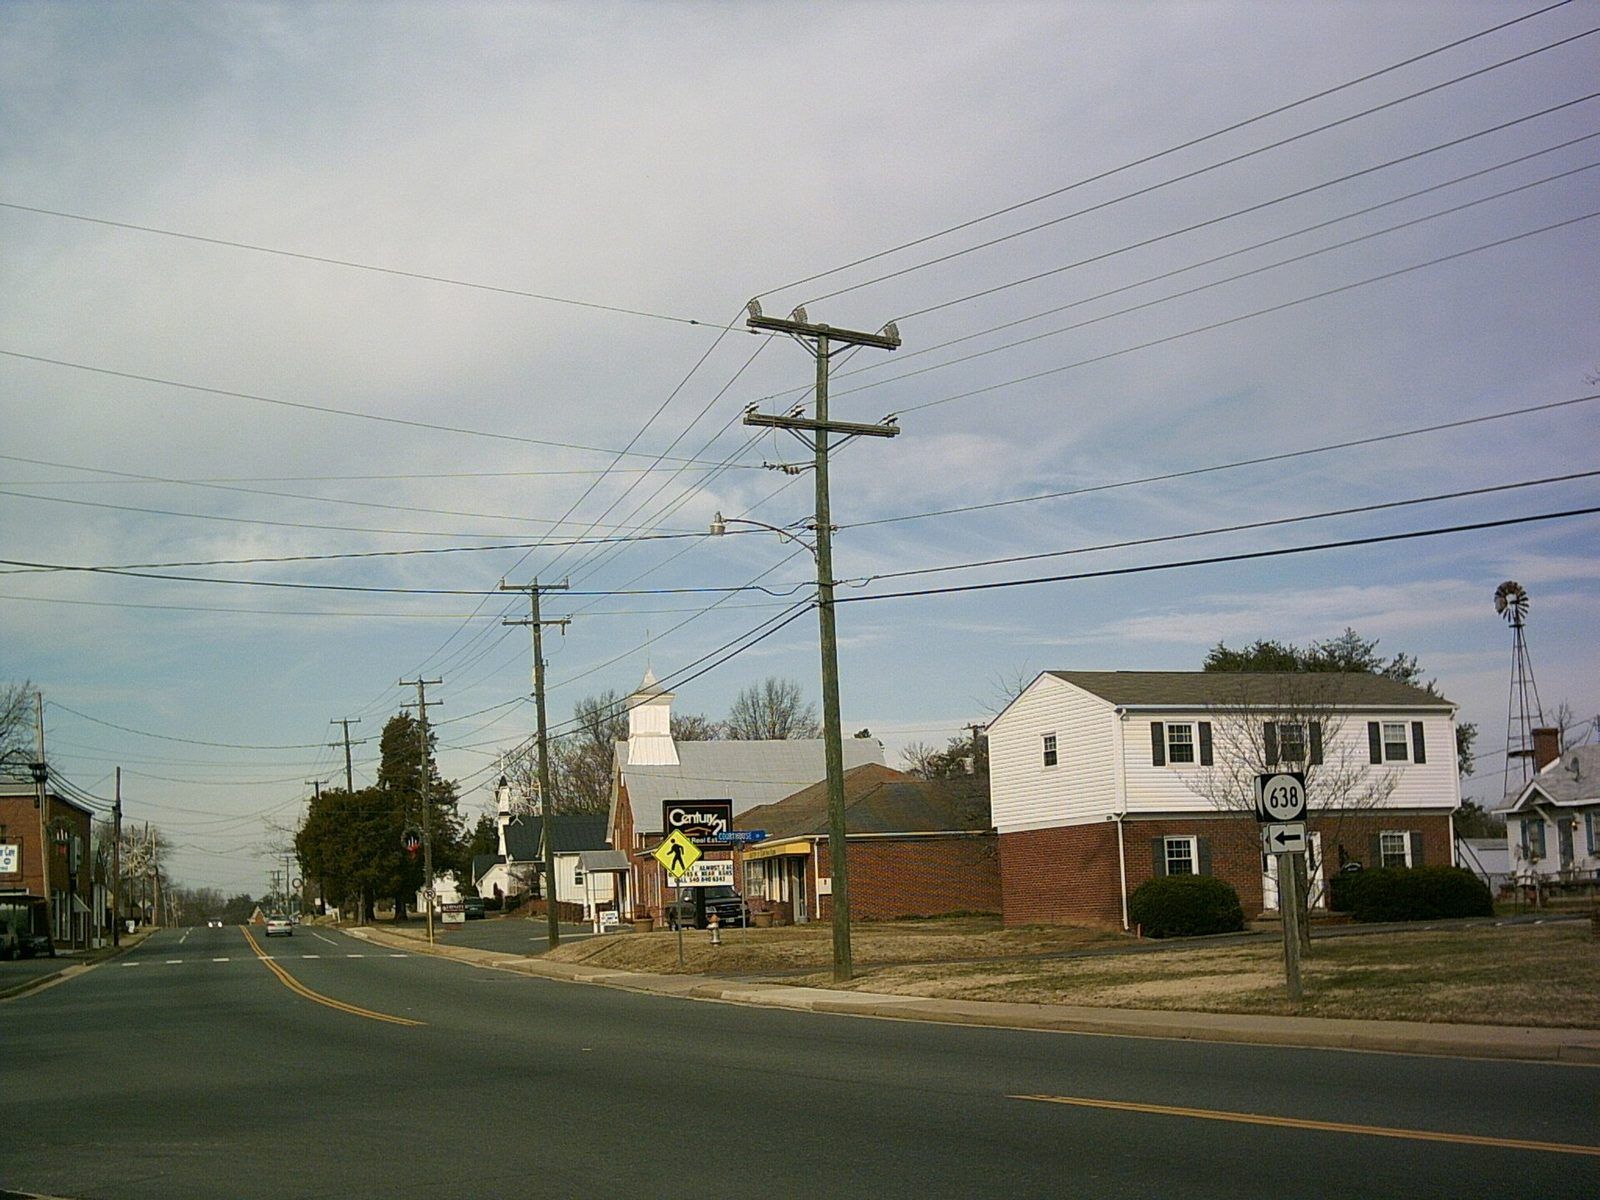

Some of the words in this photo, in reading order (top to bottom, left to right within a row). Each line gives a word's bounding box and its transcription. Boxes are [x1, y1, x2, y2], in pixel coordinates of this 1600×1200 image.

[1270, 786, 1298, 808] 638
[669, 808, 718, 826] Century
[712, 819, 727, 836] 21
